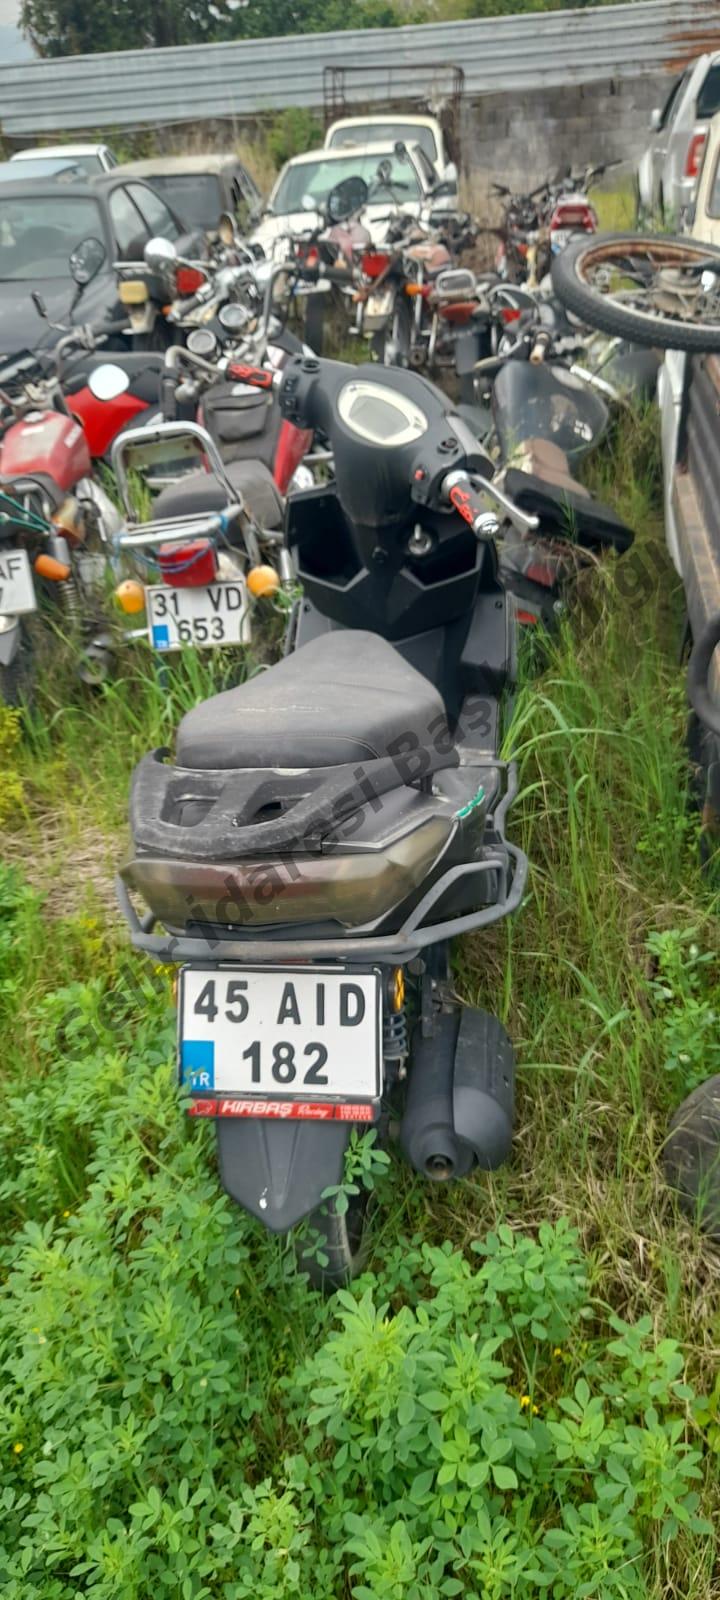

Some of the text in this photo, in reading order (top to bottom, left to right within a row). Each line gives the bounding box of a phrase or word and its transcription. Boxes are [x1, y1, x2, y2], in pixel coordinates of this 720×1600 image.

[154, 586, 242, 617] 31 VD
[178, 616, 225, 642] 653
[193, 979, 366, 1027] 45 AID
[242, 1040, 329, 1085] 182
[190, 1071, 210, 1087] TR
